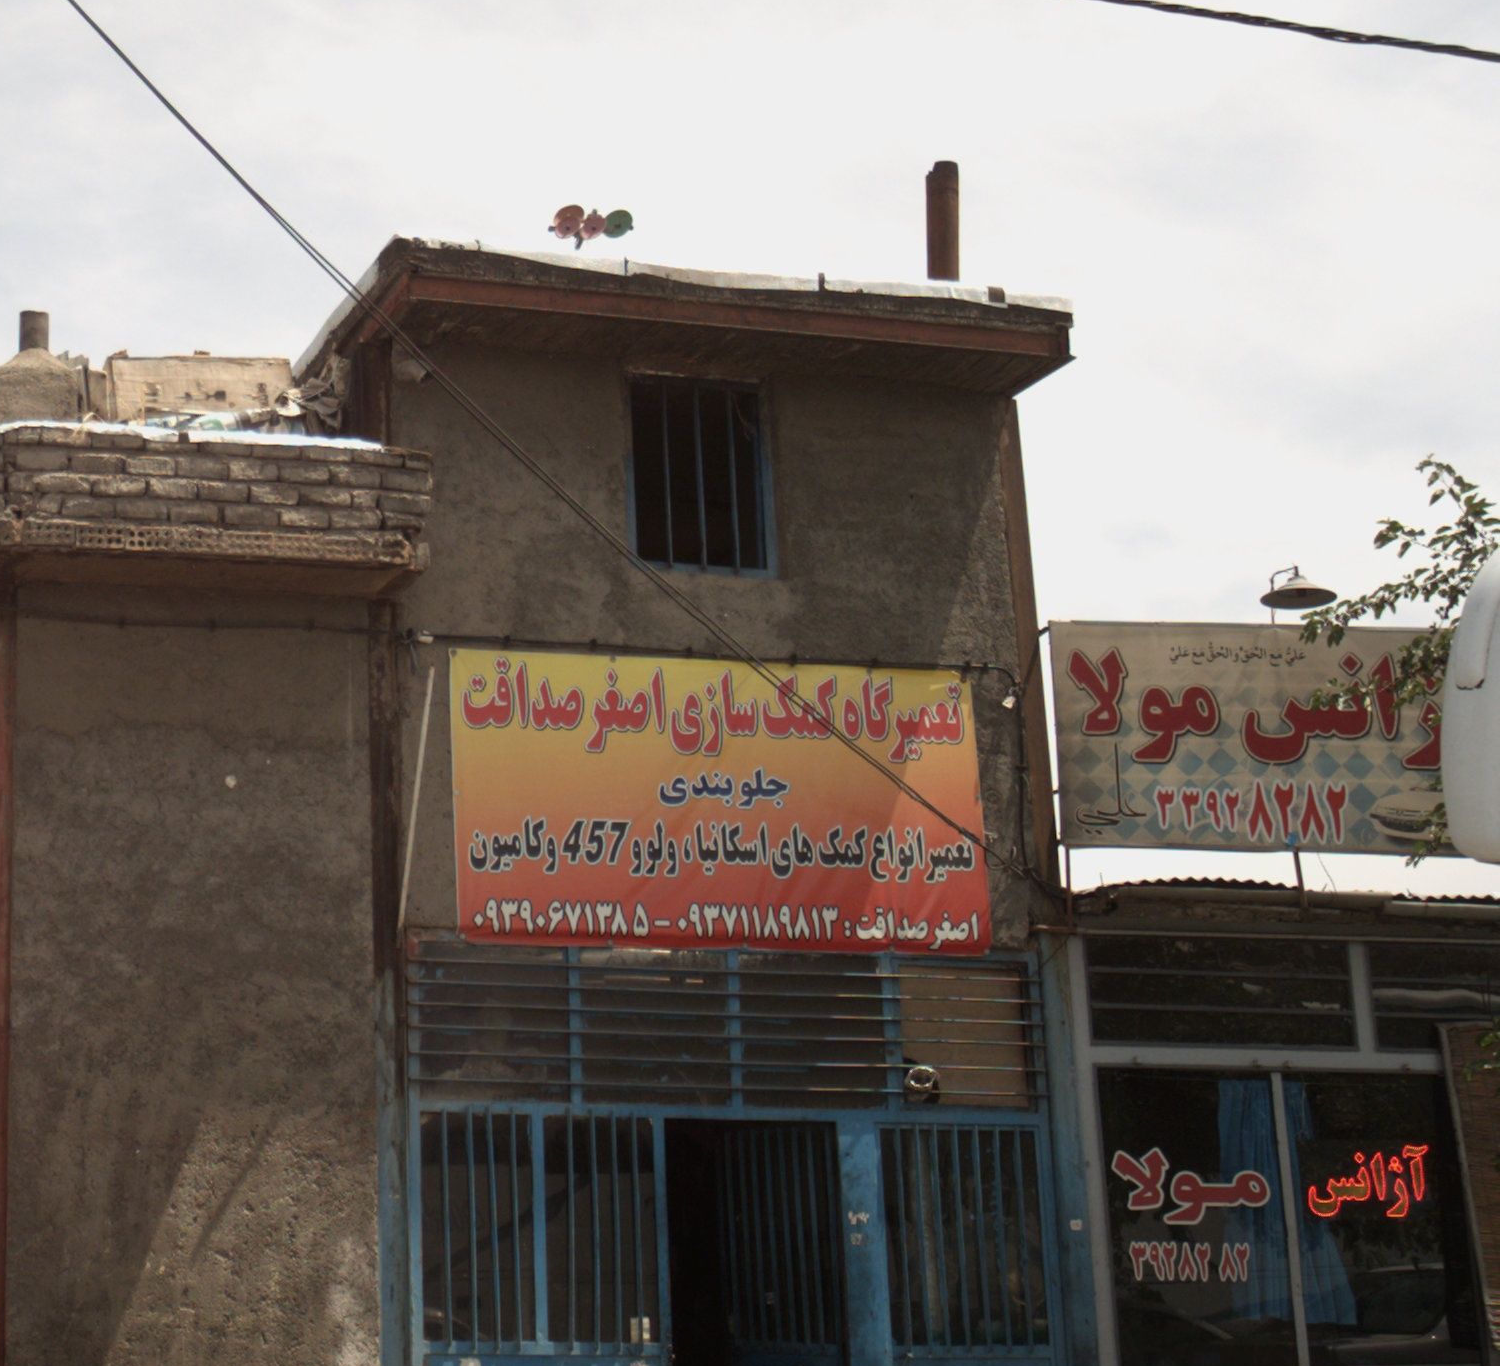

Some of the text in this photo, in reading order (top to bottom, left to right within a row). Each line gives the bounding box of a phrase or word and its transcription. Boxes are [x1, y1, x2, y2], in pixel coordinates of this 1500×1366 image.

[462, 655, 584, 731] صداقت
[584, 665, 666, 753] اصغر
[670, 667, 758, 756] سازی
[761, 673, 837, 740] کمک
[1066, 647, 1221, 764] مولا
[560, 819, 632, 866] 457
[770, 822, 816, 879] های
[817, 825, 868, 868] کمک
[869, 825, 925, 882] انواع
[927, 910, 980, 951] اصغر
[1110, 1143, 1430, 1226] آژانس مولا
